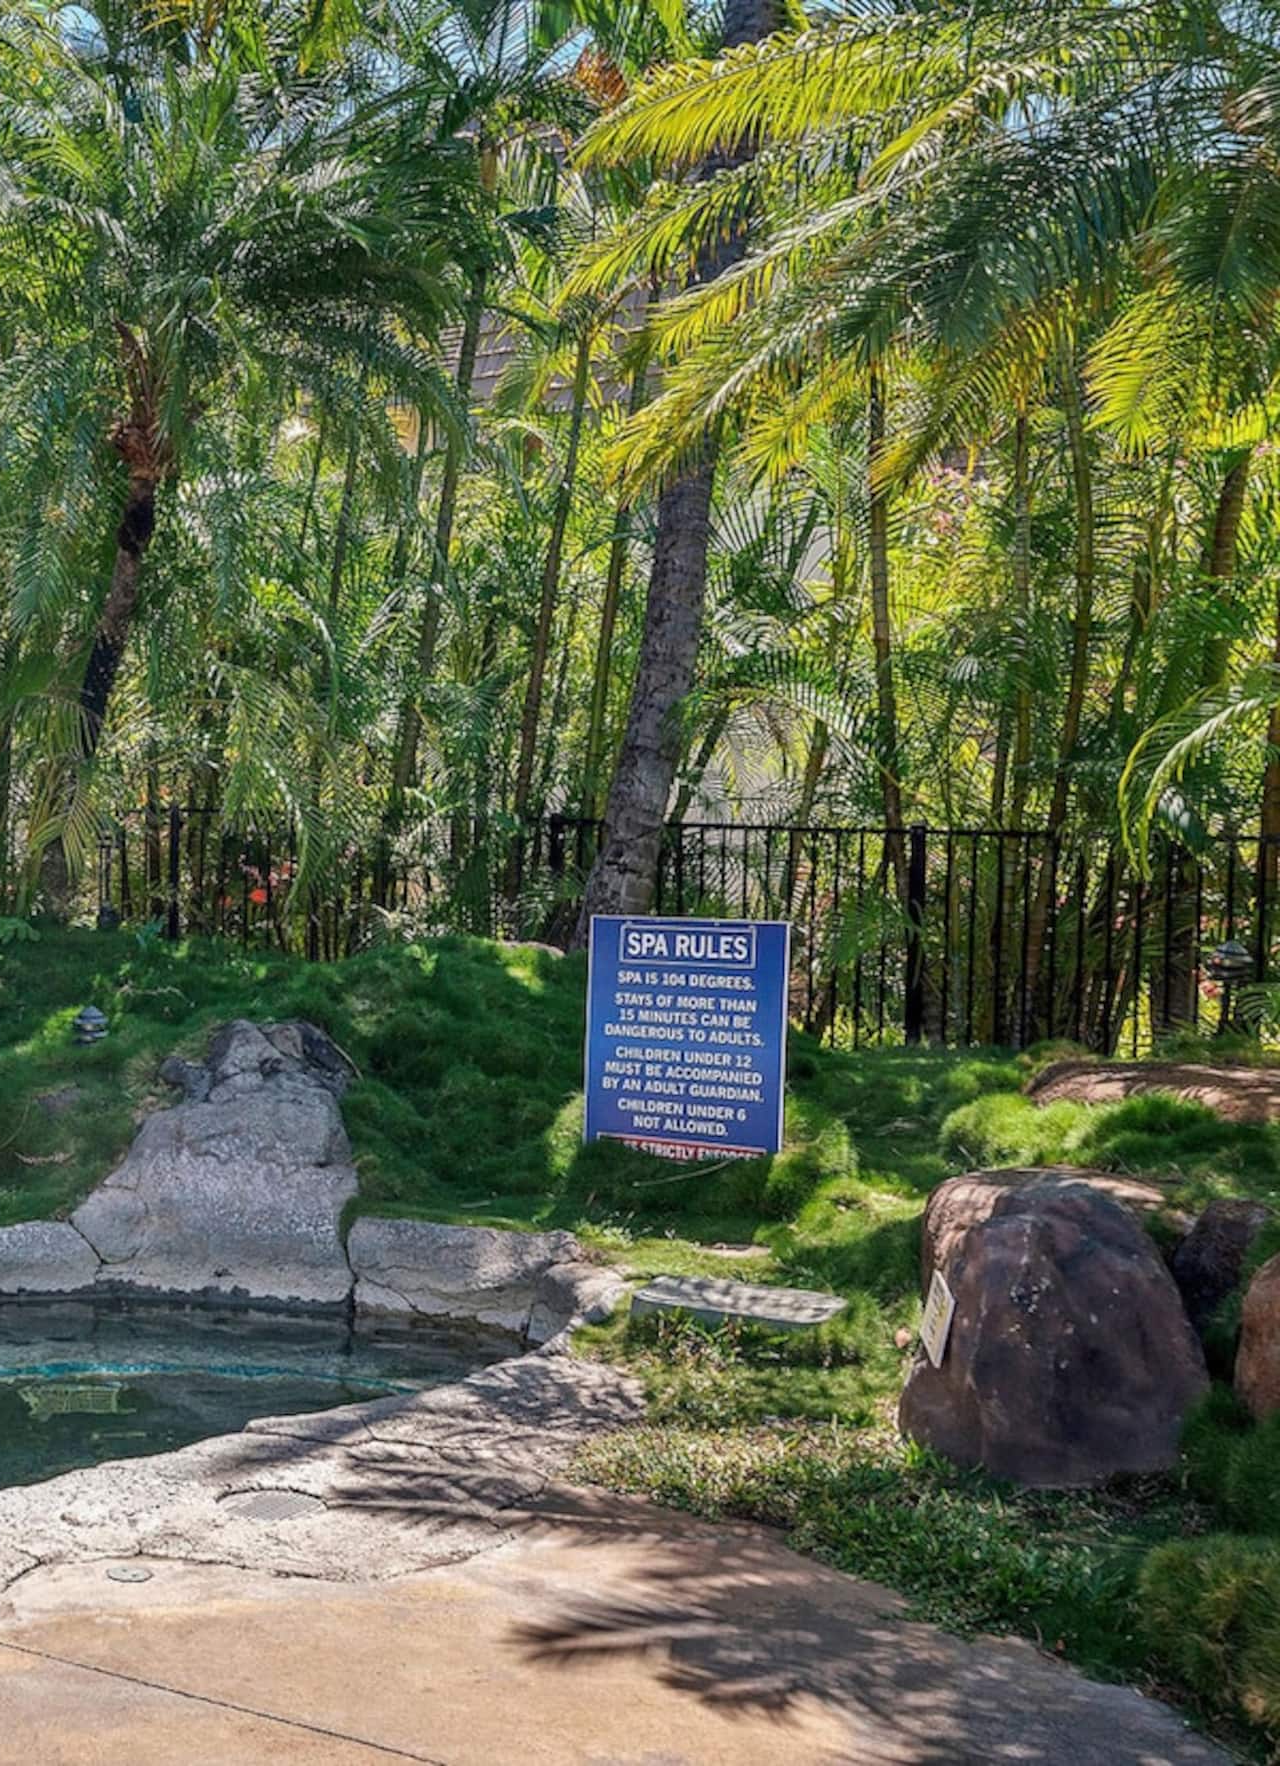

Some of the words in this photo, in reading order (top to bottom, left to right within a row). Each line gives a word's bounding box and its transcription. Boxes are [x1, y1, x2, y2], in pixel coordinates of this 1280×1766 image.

[627, 932, 668, 956] SPA
[676, 935, 747, 960] RULES
[618, 971, 642, 983] SPA
[646, 972, 658, 984] IS
[663, 973, 685, 986] 104
[689, 974, 754, 990] DEGREES.
[615, 992, 653, 1006] STAYS
[656, 995, 673, 1007] OF
[677, 996, 715, 1009] MORE
[720, 998, 756, 1012] THAN
[620, 1009, 635, 1021] 15
[638, 1010, 698, 1025] MINUTES
[701, 1014, 729, 1027] CAN
[733, 1015, 751, 1029] BE
[605, 1024, 684, 1041] DANGEROUS
[688, 1029, 706, 1042] TO
[708, 1031, 764, 1046] ADULTS.
[616, 1046, 681, 1062] CHILDREN
[684, 1052, 732, 1066] UNDER
[736, 1055, 752, 1068] 12
[605, 1061, 641, 1075] MUST
[646, 1064, 662, 1077] BE
[665, 1066, 762, 1085] ACCOMPANIED
[603, 1077, 619, 1088] BY
[623, 1079, 641, 1090] AN
[644, 1080, 686, 1094] ADULT
[689, 1084, 763, 1102] GUARDIAN.
[618, 1098, 683, 1115] CHILDREN
[687, 1104, 734, 1119] UNDER
[737, 1109, 746, 1121] 6
[634, 1115, 660, 1129] NOT
[663, 1119, 728, 1136] ALLOWED.
